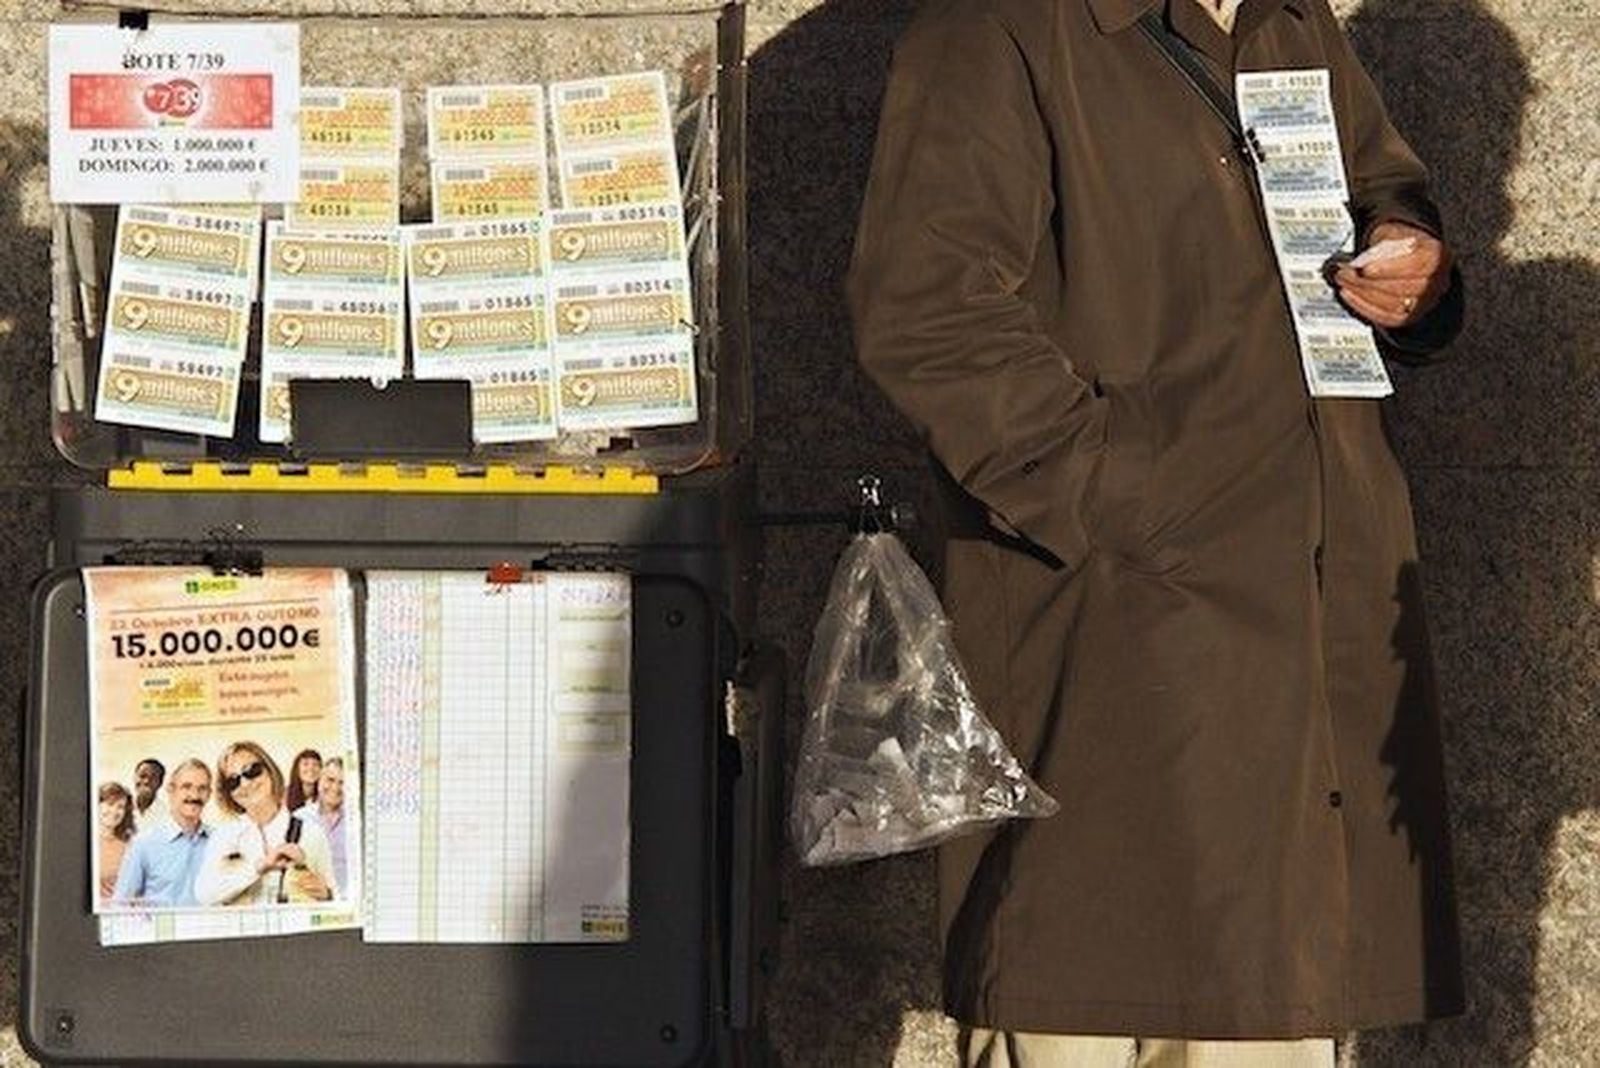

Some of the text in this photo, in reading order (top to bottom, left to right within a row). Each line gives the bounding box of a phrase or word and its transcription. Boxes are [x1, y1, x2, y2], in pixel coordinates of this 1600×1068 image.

[122, 53, 225, 69] BOTE 7/39
[89, 138, 163, 151] JUEVES:
[174, 138, 244, 151] 1.000.000
[79, 158, 175, 173] DOMINGO:
[185, 158, 256, 173] 2.000.000
[198, 612, 251, 627] EXTRA
